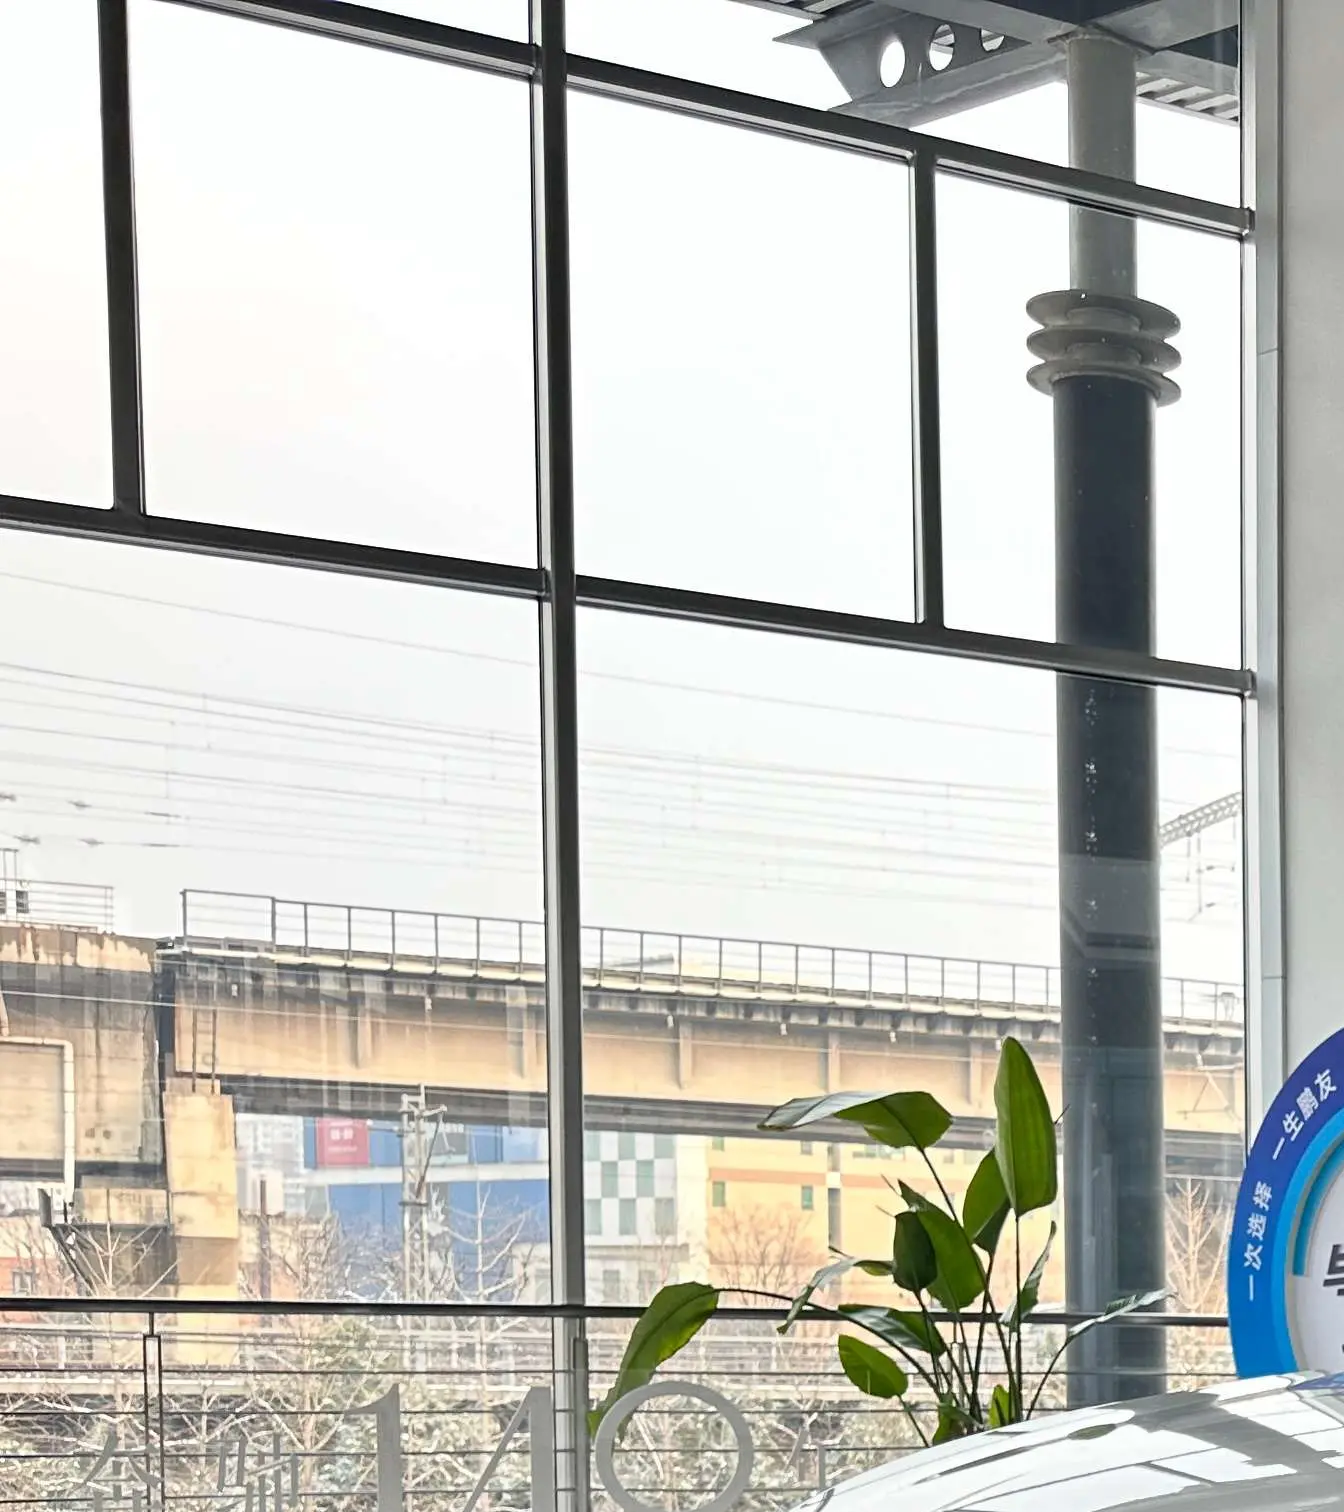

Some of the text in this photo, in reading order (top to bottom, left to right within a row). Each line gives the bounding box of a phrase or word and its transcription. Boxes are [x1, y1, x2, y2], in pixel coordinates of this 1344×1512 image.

[1244, 1068, 1338, 1301] 一次选择 一生鹏友
